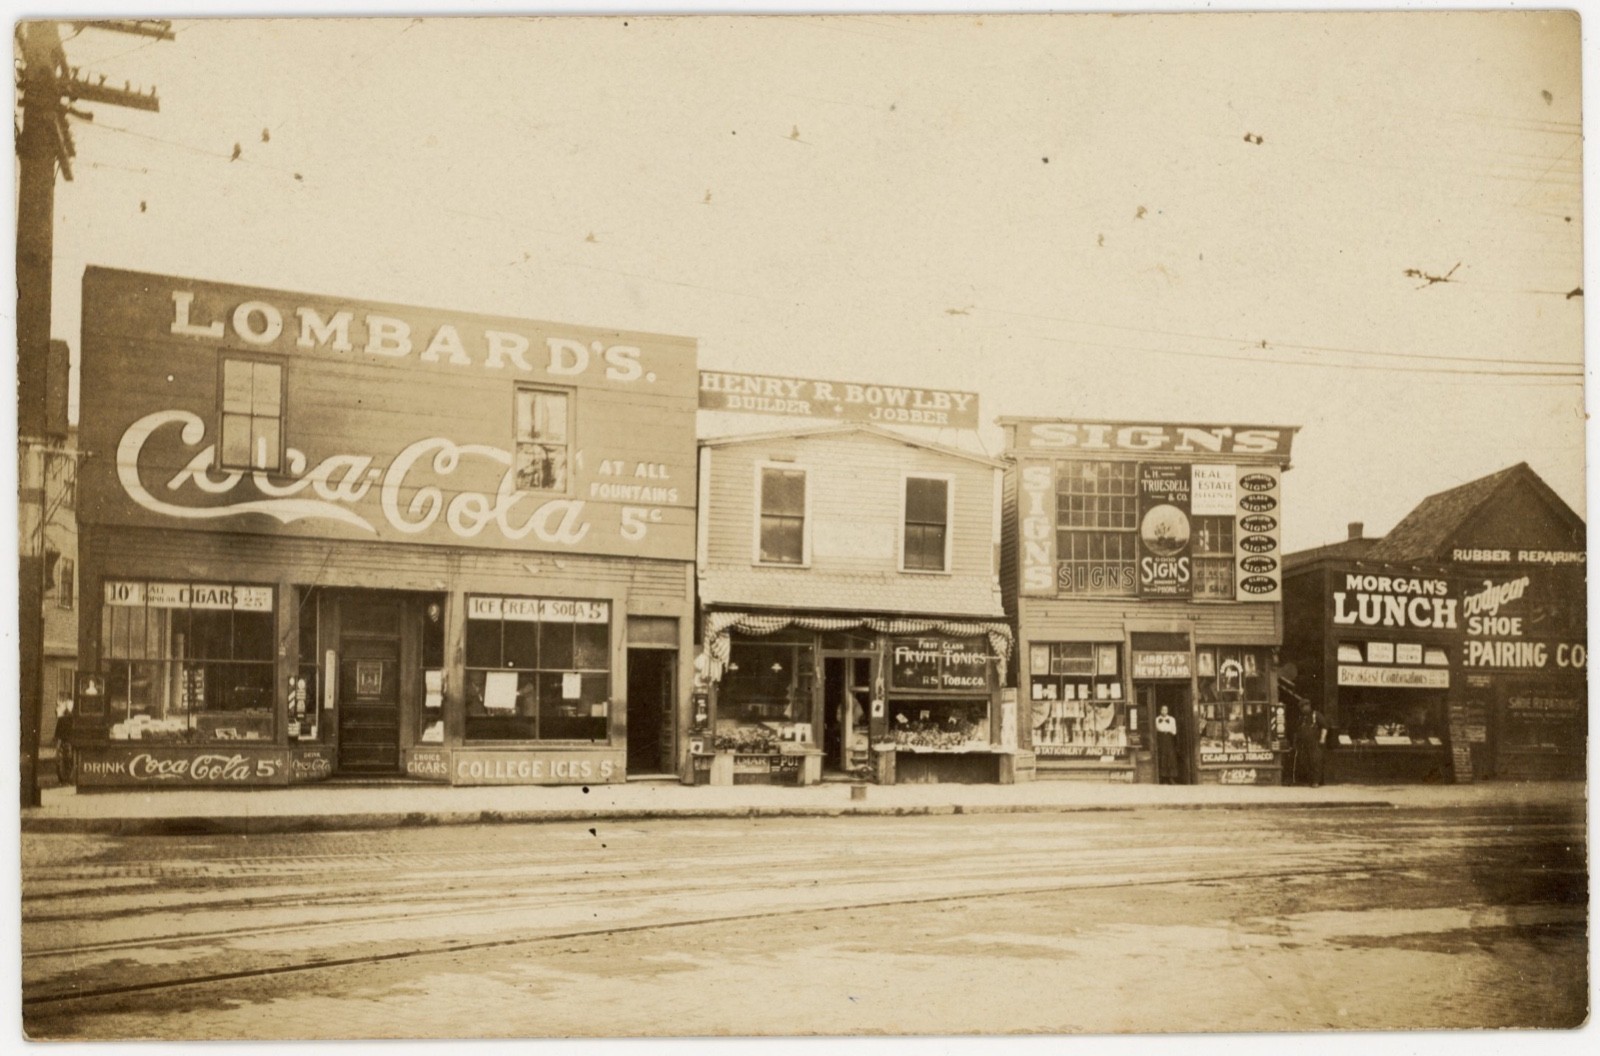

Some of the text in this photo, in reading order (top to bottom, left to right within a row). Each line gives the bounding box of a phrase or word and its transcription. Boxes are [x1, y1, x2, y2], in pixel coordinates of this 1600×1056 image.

[171, 291, 656, 383] LOMBARD'S.
[700, 372, 973, 412] HENRY R. BOWLBY
[726, 395, 811, 415] BUILDER
[869, 407, 948, 425] JOBBER
[598, 458, 670, 480] AT ALL
[1194, 469, 1221, 479] REAL
[590, 482, 678, 503] FOUNTAINS
[1140, 479, 1190, 492] TRUESDELL
[1198, 480, 1234, 490] ESTATE
[1242, 482, 1274, 491] SIGNS
[1242, 502, 1274, 511] SIGNS
[1021, 465, 1052, 591] SIGNS
[1242, 522, 1274, 532] SIGNS
[1242, 543, 1274, 552] SIGNS
[1453, 548, 1511, 562] RUBBER
[1057, 565, 1136, 589] SIGNS
[1140, 556, 1190, 584] SIGNS
[1243, 563, 1274, 573] SIGNS
[1243, 583, 1274, 593] SIGNS
[1346, 573, 1448, 595] MORGAN'S
[178, 588, 239, 606] CIGARS
[1463, 576, 1530, 618] oodyear
[474, 599, 496, 614] ICE
[500, 600, 546, 616] CREAM
[552, 602, 586, 617] SODA
[1333, 592, 1458, 629] LUNCH
[1467, 616, 1523, 635] SHOE
[895, 646, 987, 667] FRUIT TONICS
[1134, 663, 1161, 677] NEWS
[413, 753, 441, 761] CHOICE
[83, 761, 126, 774] DRINK
[129, 753, 189, 780] Coca
[190, 753, 251, 780] Cola
[407, 761, 448, 774] CIGARS
[457, 760, 544, 778] COLLEGE
[550, 760, 592, 778] ICES
